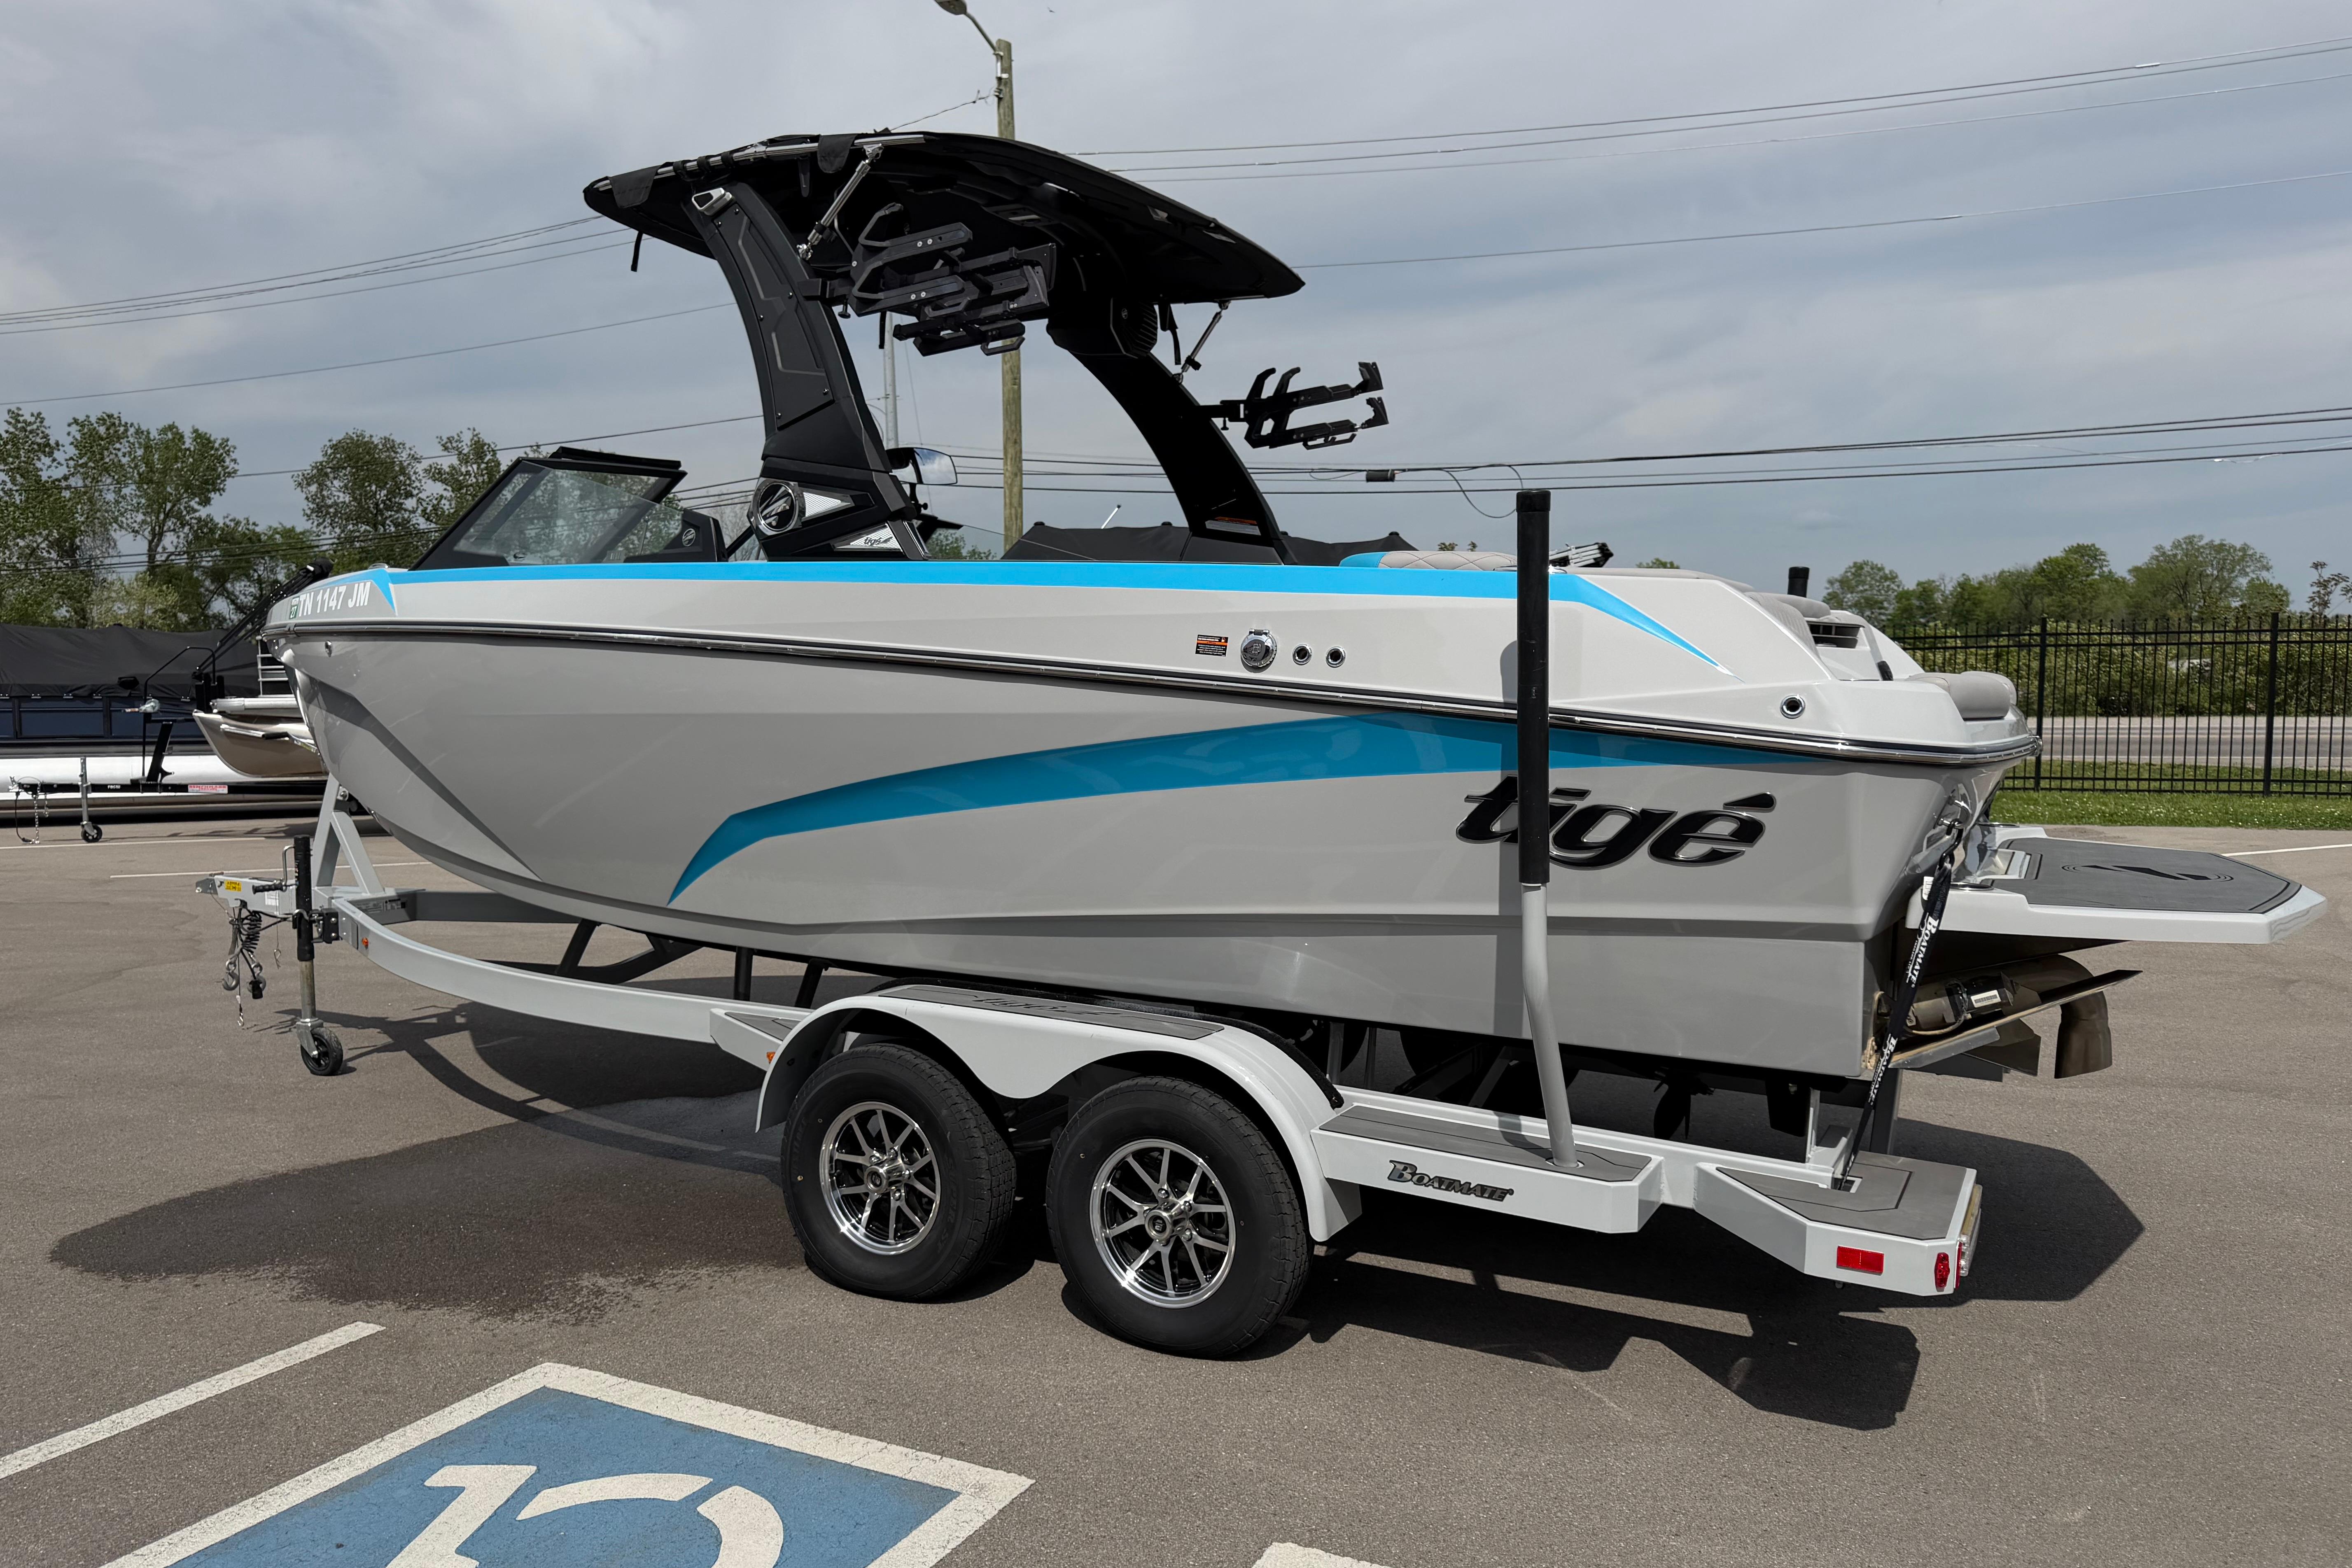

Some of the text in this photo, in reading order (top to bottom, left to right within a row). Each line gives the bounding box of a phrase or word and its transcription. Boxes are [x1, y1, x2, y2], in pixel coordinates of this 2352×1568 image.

[290, 606, 297, 618] 27
[299, 581, 371, 617] TN 1147 JM
[1911, 916, 1939, 985] BOATMATE
[1388, 1160, 1510, 1202] BOATMATE
